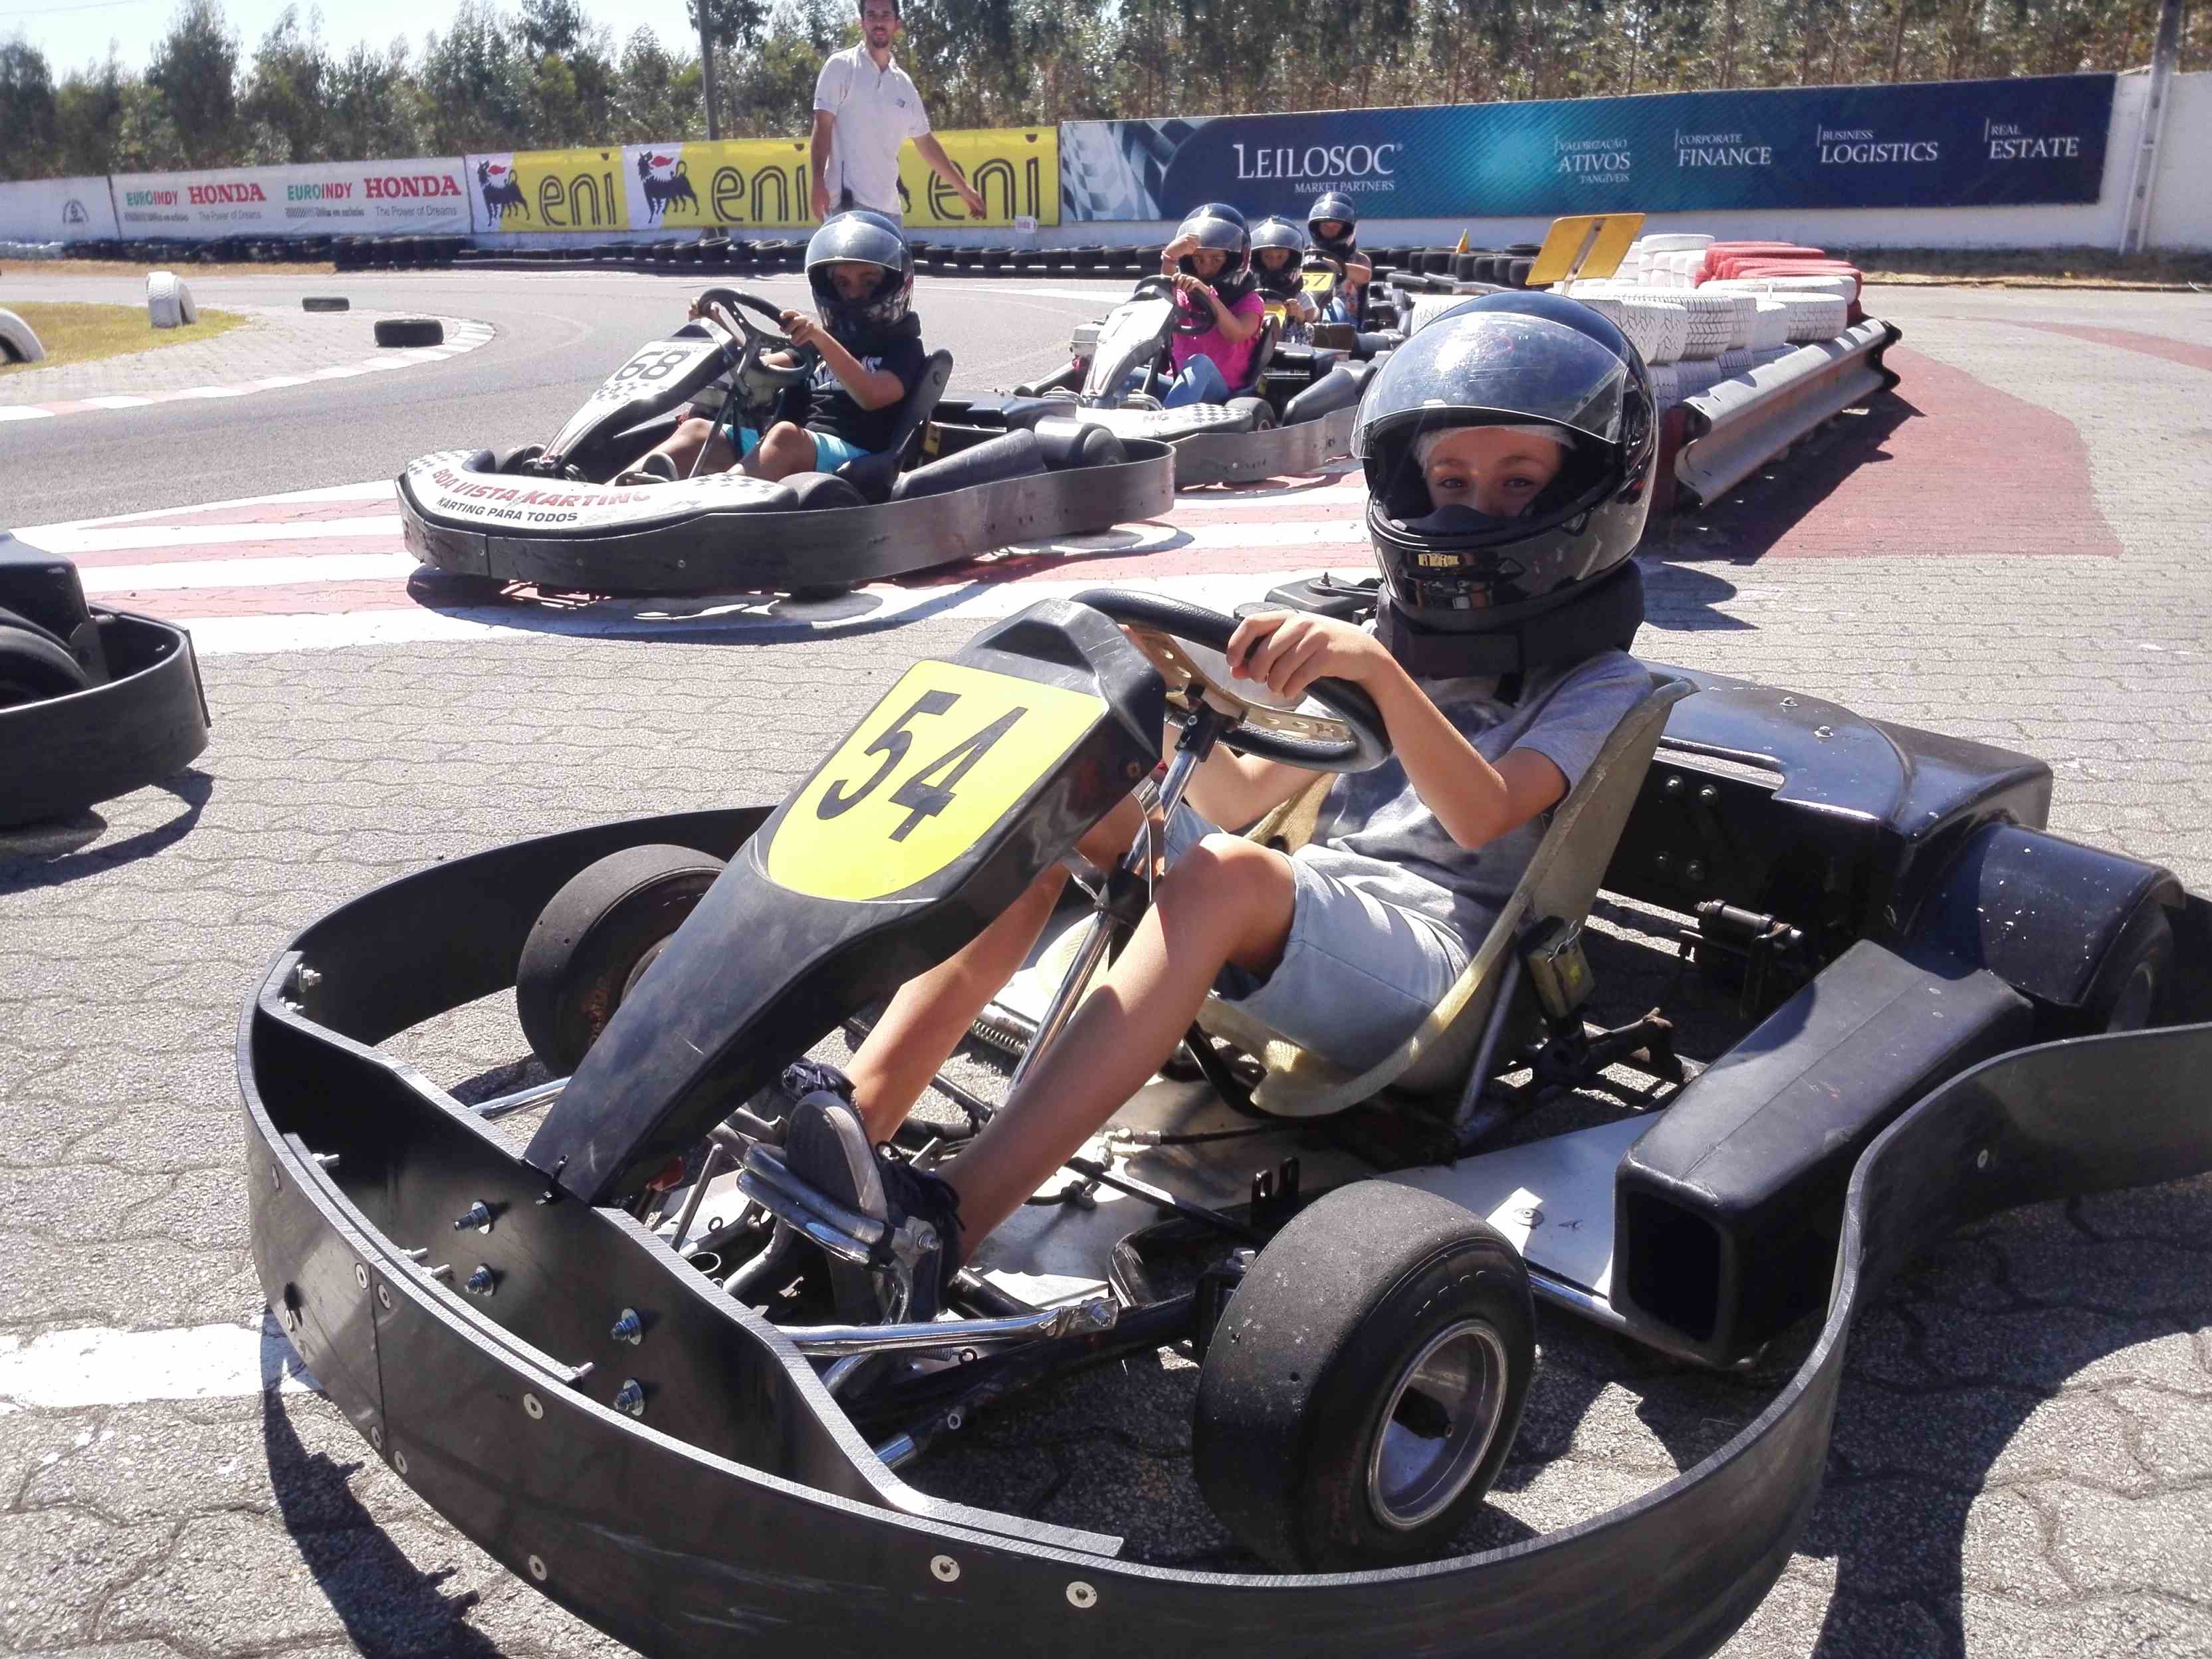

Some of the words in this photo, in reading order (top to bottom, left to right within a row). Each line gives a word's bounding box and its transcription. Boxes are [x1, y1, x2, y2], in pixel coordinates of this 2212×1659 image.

[1680, 134, 1742, 145] CORPORATE
[1823, 130, 1873, 140] BUSINESS
[1991, 124, 2021, 135] REAL
[1678, 146, 1772, 167] FINANCE
[1821, 142, 1939, 164] LOGISTICS
[1989, 137, 2080, 160] ESTATE
[1232, 144, 1395, 179] LEILOSOC
[1557, 152, 1631, 172] ATIVOS
[287, 182, 352, 200] EUROINDY
[364, 175, 462, 198] HONDA
[539, 152, 617, 226] eni
[712, 143, 809, 222] eni
[928, 134, 1040, 221] eni
[1295, 182, 1338, 193] MARKET
[1340, 180, 1395, 192] PARTNERS
[126, 190, 179, 206] EUROINDY
[187, 181, 267, 205] HONDA
[376, 206, 390, 217] The
[615, 350, 691, 381] 68
[433, 469, 460, 489] BOA
[452, 482, 520, 501] VISTA
[436, 497, 486, 515] KARTING
[487, 508, 522, 520] PARA
[526, 512, 578, 522] TODOS
[816, 689, 1028, 843] 54
